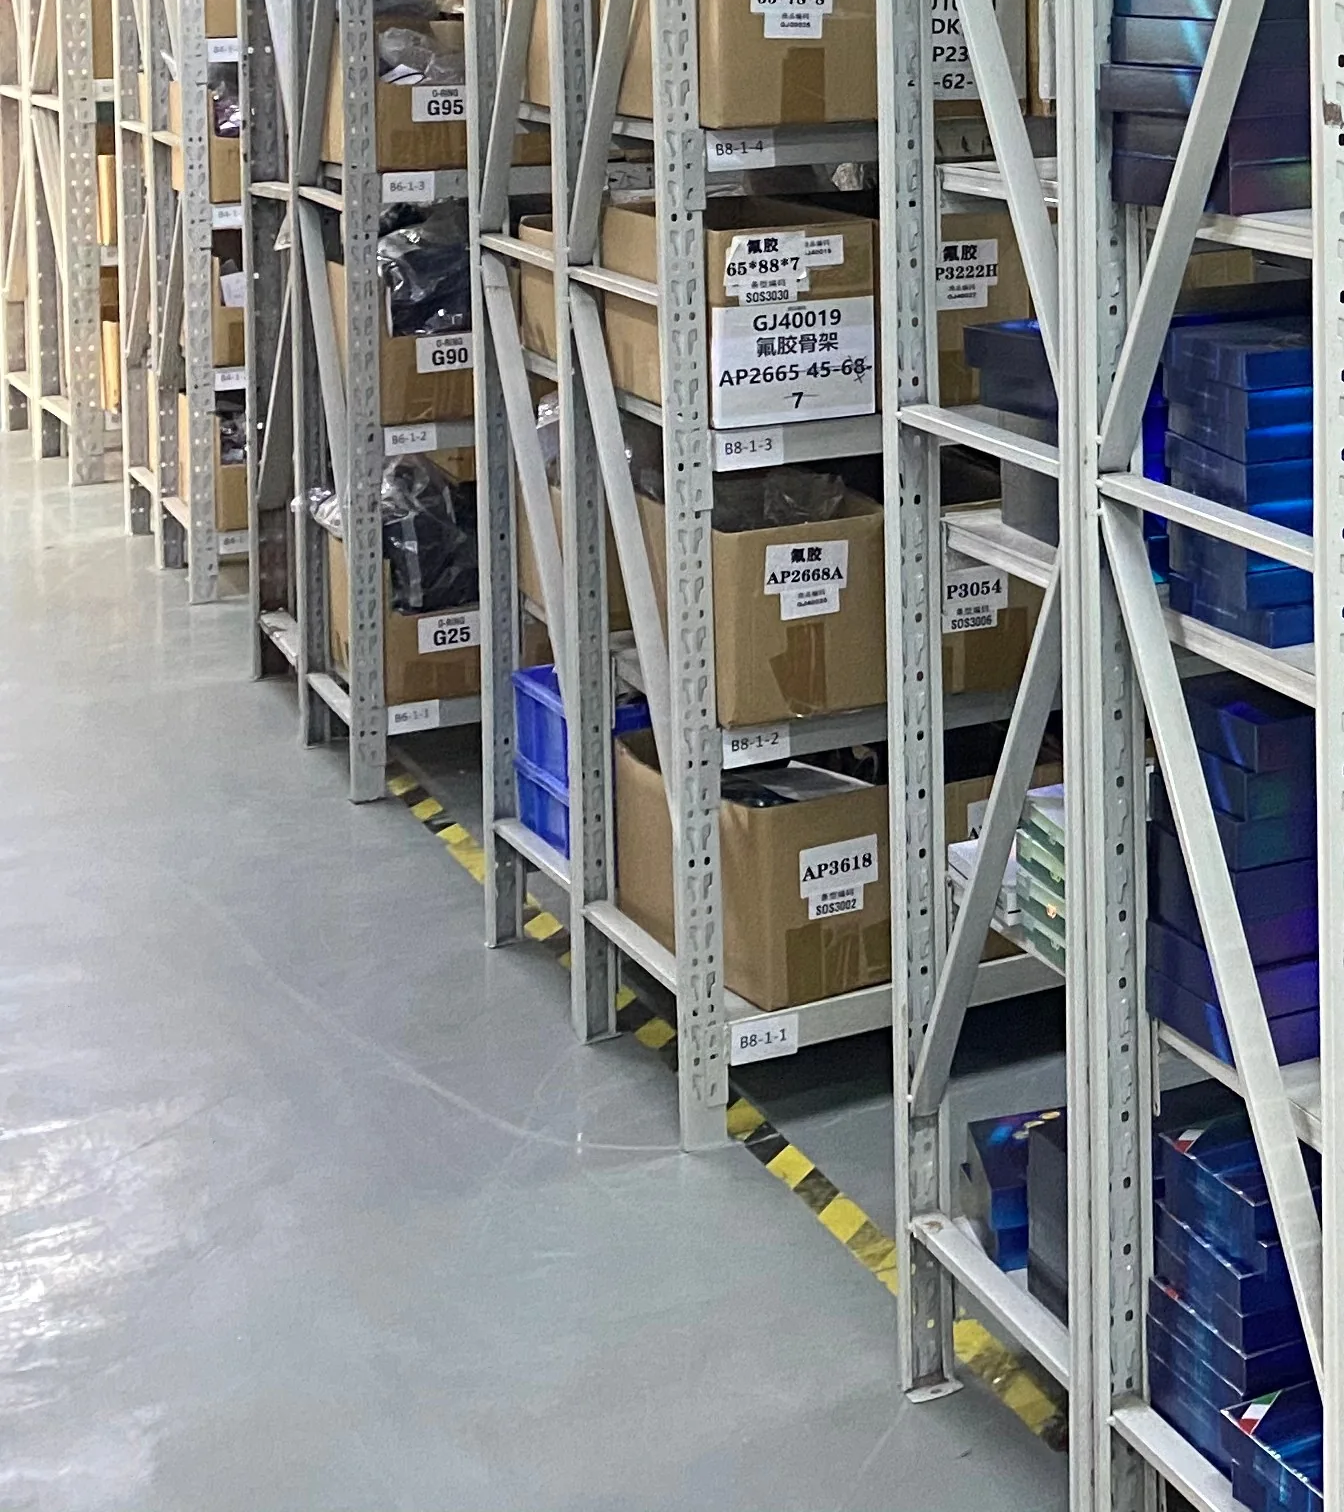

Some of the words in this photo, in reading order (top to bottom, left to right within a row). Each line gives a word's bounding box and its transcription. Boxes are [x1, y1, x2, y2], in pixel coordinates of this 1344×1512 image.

[428, 99, 464, 116] G95
[715, 140, 764, 156] B8-1-4
[753, 309, 842, 331] GJ40019
[756, 332, 839, 357] 氟胶骨架
[432, 347, 468, 365] G90
[719, 364, 800, 387] AP2665
[792, 392, 804, 409] 7
[725, 438, 773, 455] B8-1-3
[766, 566, 844, 585] AP2668A
[434, 627, 471, 646] G25
[731, 731, 779, 752] B8-1-2
[801, 852, 873, 882] AP3618
[740, 1028, 787, 1050] B8-1-1
